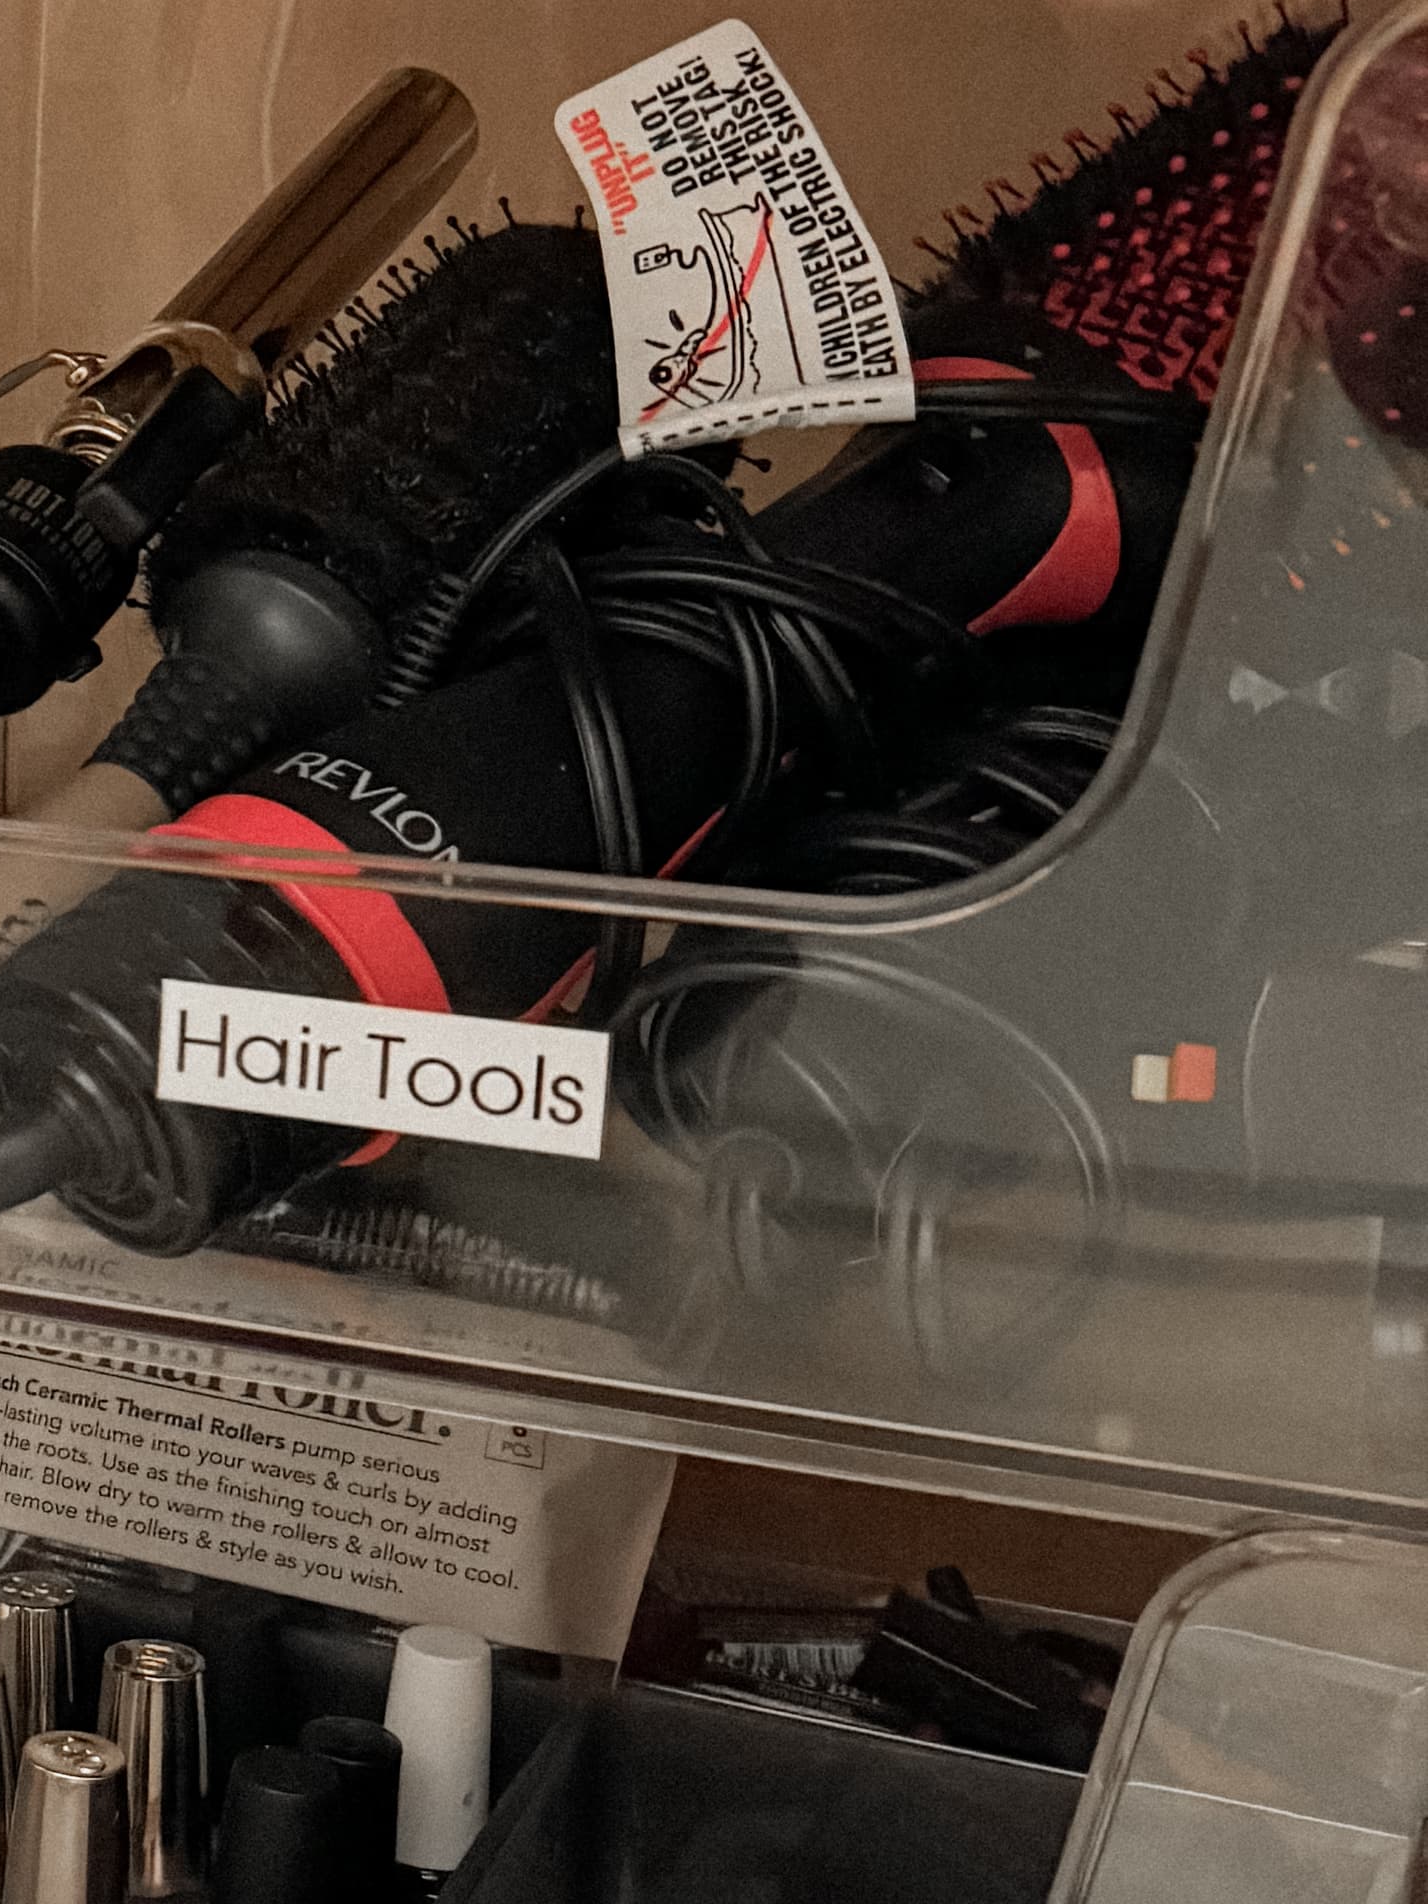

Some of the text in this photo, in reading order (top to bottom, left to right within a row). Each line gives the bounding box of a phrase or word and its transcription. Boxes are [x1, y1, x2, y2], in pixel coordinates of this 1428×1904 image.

[631, 95, 699, 198] DO NOT
[656, 75, 726, 187] REMOVE
[678, 55, 756, 186] THIS TAG!
[720, 79, 772, 151] RISK
[734, 46, 805, 146] SHOCK!
[751, 143, 797, 204] THE
[779, 203, 818, 237] OF
[789, 146, 870, 273] ELECTRIC
[797, 238, 861, 372] CHILDREN
[844, 276, 885, 313] BY
[855, 312, 899, 379] EATH
[6, 477, 67, 518] HOT
[177, 1009, 585, 1125] Hair Tools
[24, 1377, 109, 1413] Ceramic
[115, 1395, 204, 1433] Thermal
[209, 1416, 286, 1450] Rollers
[291, 1435, 357, 1467] pump
[361, 1453, 441, 1484] serious
[69, 1419, 145, 1449] volume
[150, 1435, 192, 1459] into
[196, 1447, 245, 1472] your
[250, 1460, 317, 1488] waves
[322, 1470, 340, 1492] &
[346, 1480, 398, 1505] curls
[403, 1488, 432, 1515] by
[437, 1499, 519, 1535] adding
[2, 1429, 32, 1452] the
[35, 1440, 93, 1466] roots.
[101, 1450, 141, 1476] Use
[145, 1464, 168, 1484] as
[174, 1469, 209, 1492] the
[216, 1476, 305, 1517] finishing
[311, 1502, 373, 1529] touch
[379, 1516, 409, 1536] on
[414, 1523, 492, 1555] almost
[3, 1491, 79, 1520] remove
[84, 1504, 119, 1529] the
[123, 1516, 190, 1546] rollers
[194, 1529, 213, 1551] &
[218, 1536, 268, 1564] style
[273, 1548, 297, 1570] as
[302, 1556, 344, 1580] you
[349, 1564, 405, 1595] wish.
[41, 1465, 93, 1495] Blow
[97, 1479, 133, 1507] dry
[138, 1489, 161, 1509] to
[166, 1498, 225, 1524] warm
[230, 1509, 267, 1534] the
[271, 1521, 340, 1551] rollers
[343, 1534, 362, 1556] &
[368, 1541, 430, 1571] allow
[434, 1556, 458, 1578] to
[463, 1564, 521, 1592] cool.
